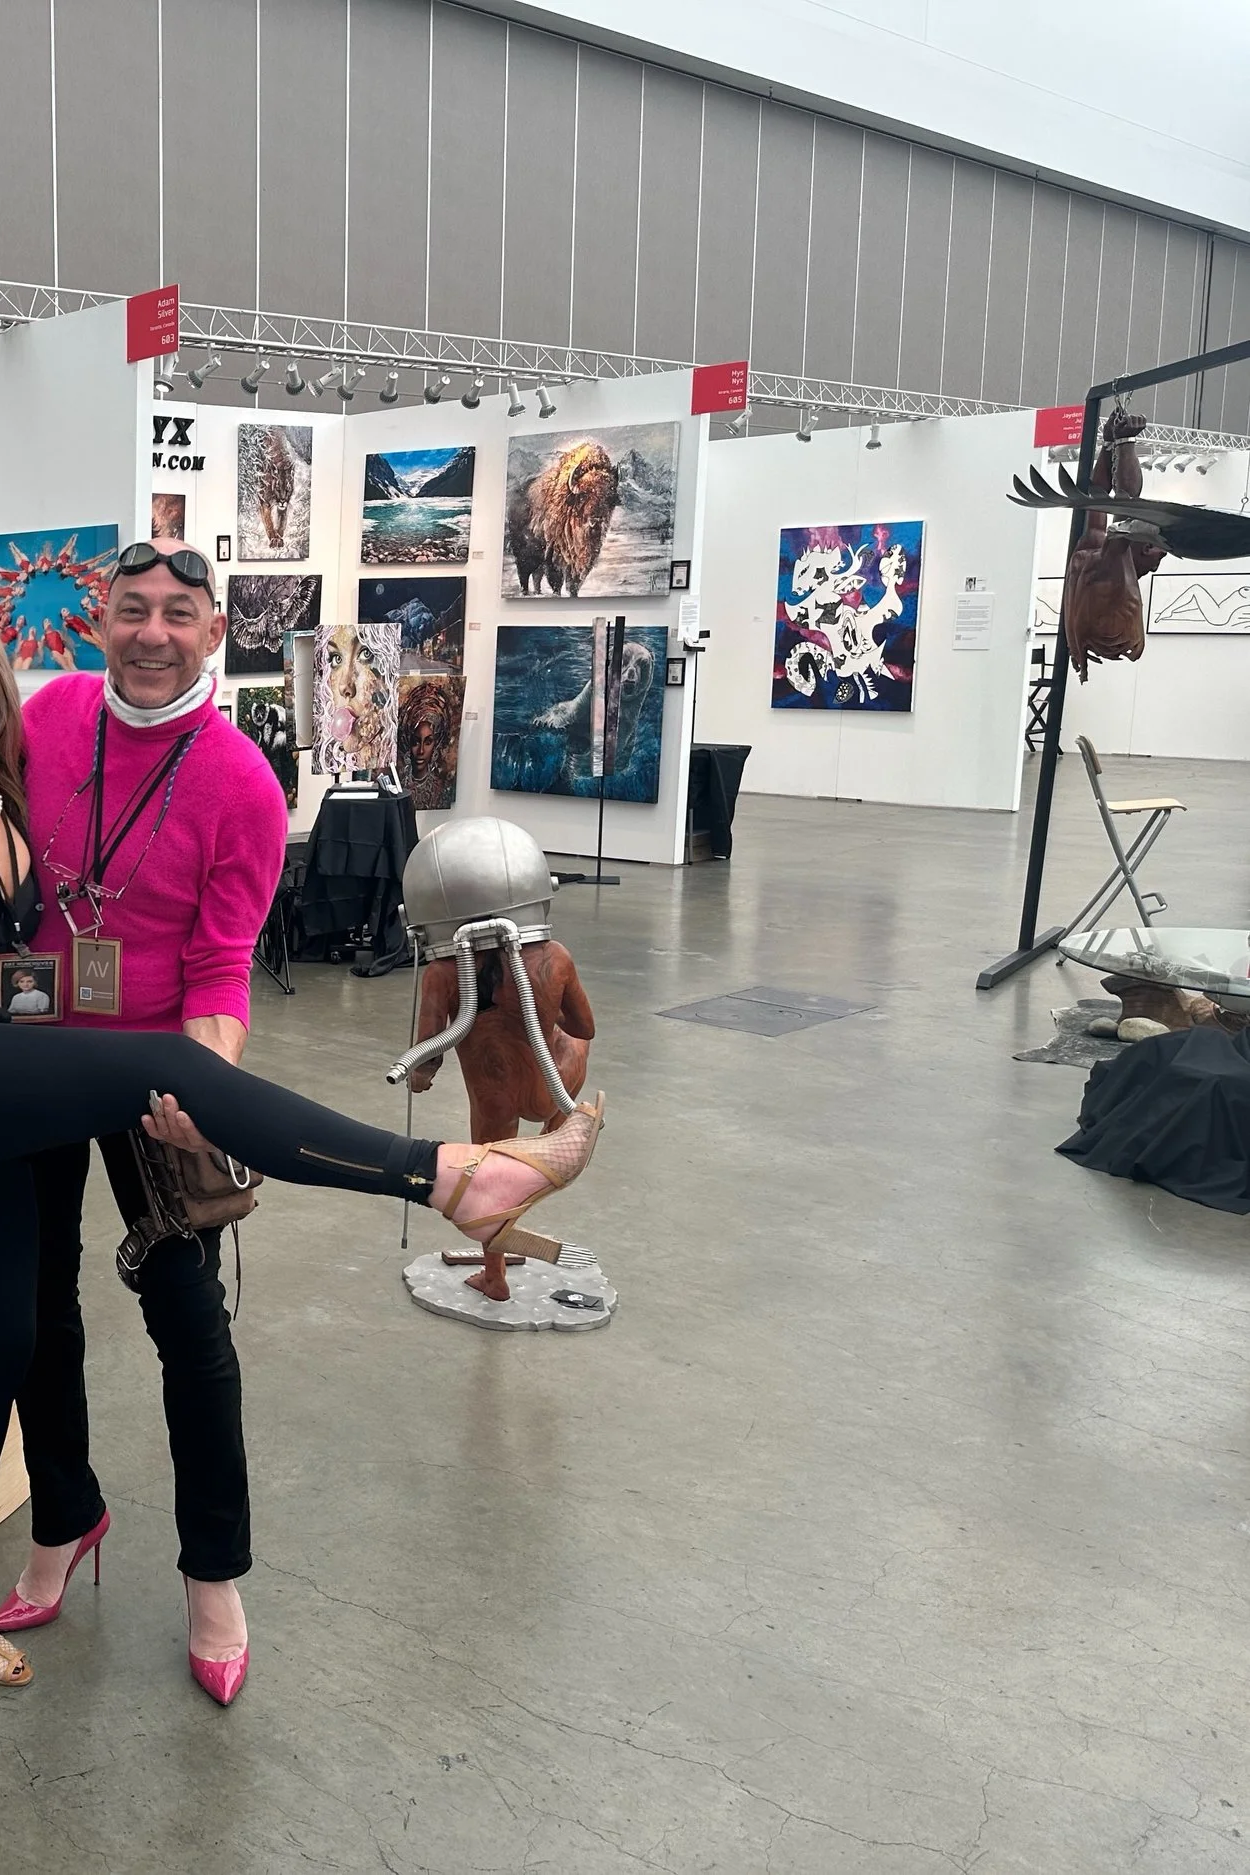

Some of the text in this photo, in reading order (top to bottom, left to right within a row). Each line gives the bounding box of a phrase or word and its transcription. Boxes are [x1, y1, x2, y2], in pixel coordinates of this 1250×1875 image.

[157, 298, 175, 308] Adam
[157, 308, 175, 319] Silver
[161, 333, 175, 345] 603
[731, 378, 744, 386] Nyx
[728, 396, 743, 404] 605
[153, 415, 195, 445] YX
[86, 960, 109, 978] AV
